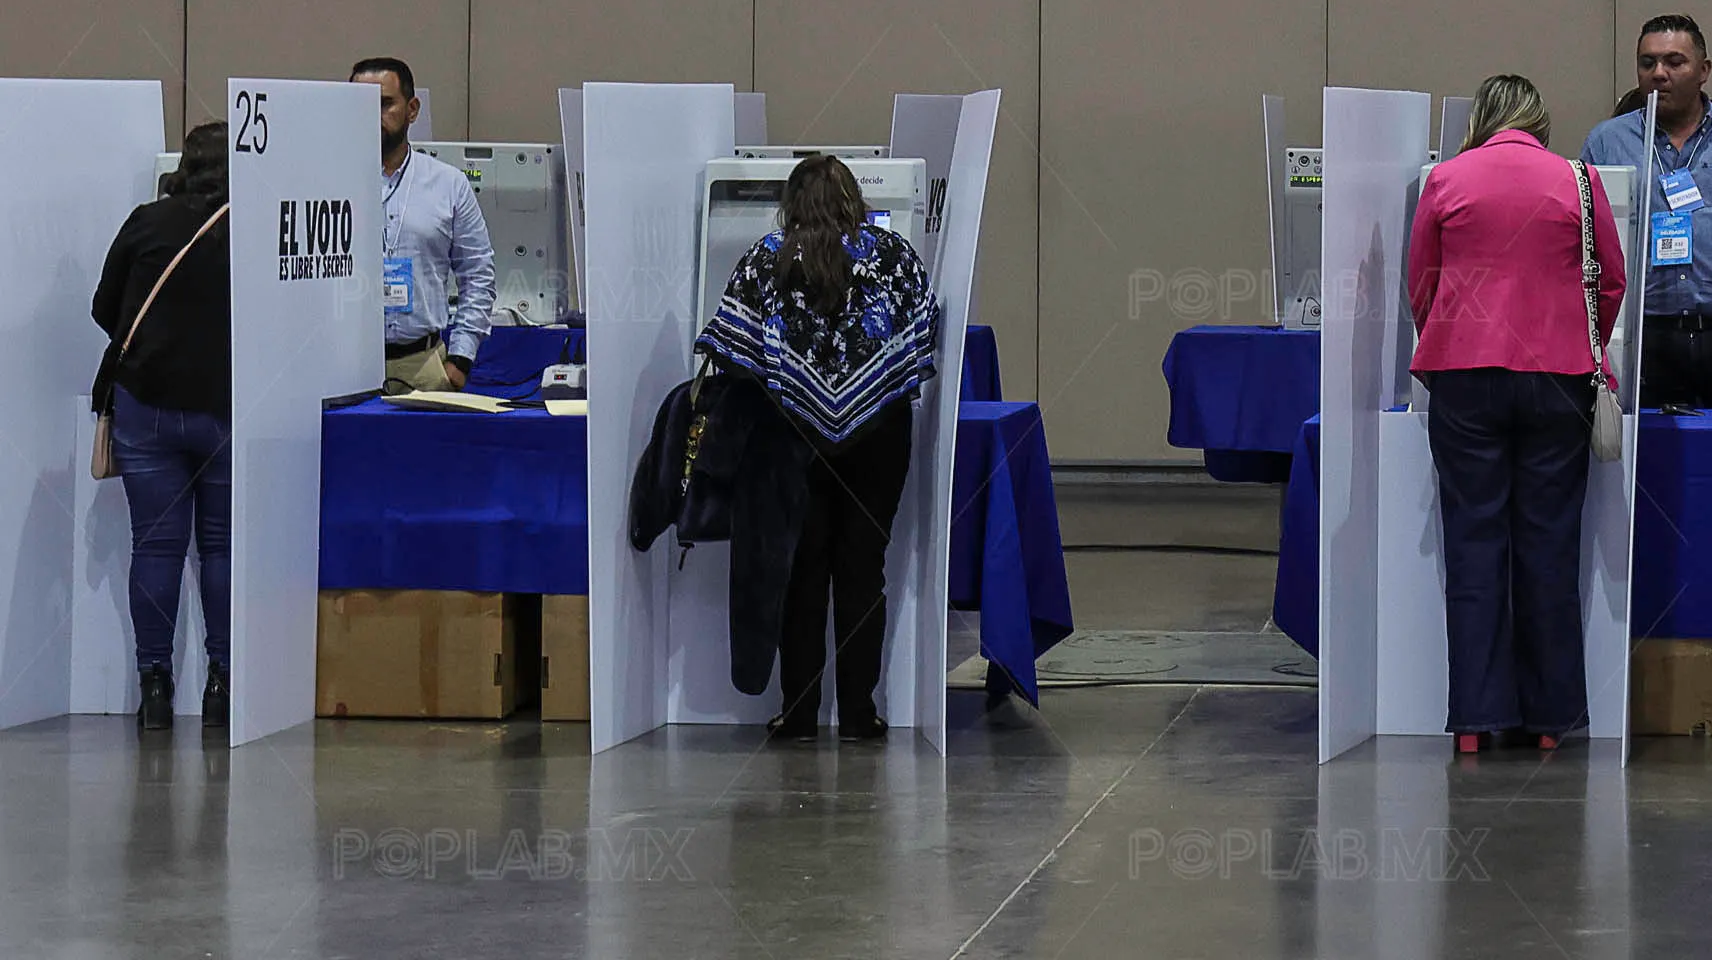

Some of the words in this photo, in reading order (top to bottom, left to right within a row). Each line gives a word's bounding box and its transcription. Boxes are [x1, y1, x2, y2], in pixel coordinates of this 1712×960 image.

[236, 90, 268, 155] 25
[860, 175, 884, 185] decide
[279, 200, 299, 257] EL
[305, 199, 352, 256] VOTO
[1584, 217, 1594, 252] GUESS
[279, 256, 289, 280] ES
[291, 255, 314, 280] LIBRE
[316, 255, 321, 279] Y
[322, 254, 353, 279] SECRETO
